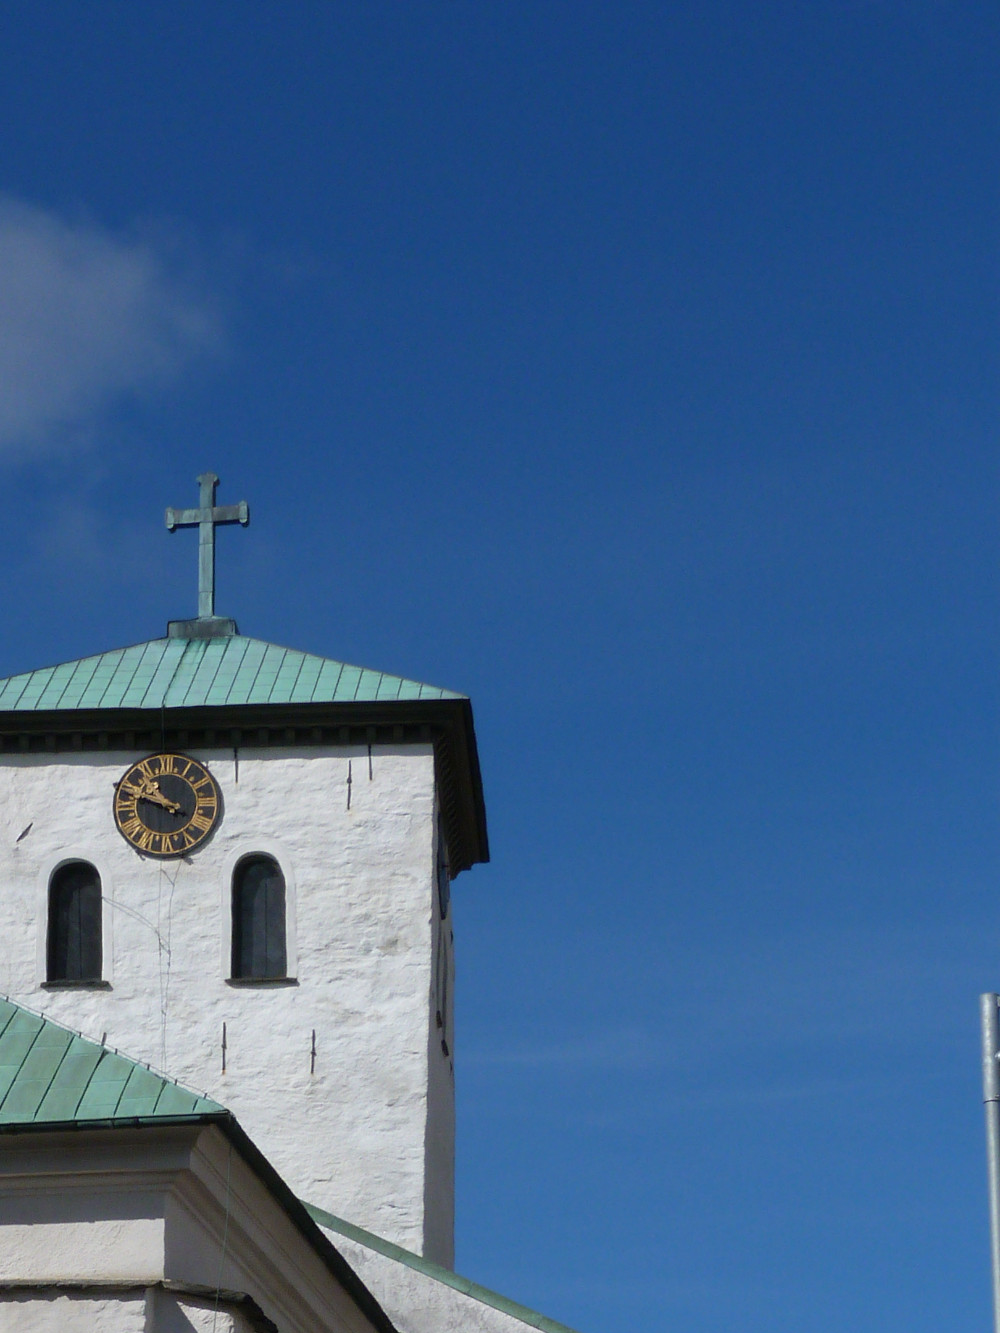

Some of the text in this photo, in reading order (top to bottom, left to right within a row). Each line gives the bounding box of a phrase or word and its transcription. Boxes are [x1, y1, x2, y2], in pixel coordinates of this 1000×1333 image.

[159, 756, 174, 774] XII
[182, 761, 193, 776] I
[193, 776, 210, 789] II
[117, 801, 135, 811] IX
[197, 797, 216, 807] III
[161, 835, 174, 852] VI
[183, 831, 196, 847] V
